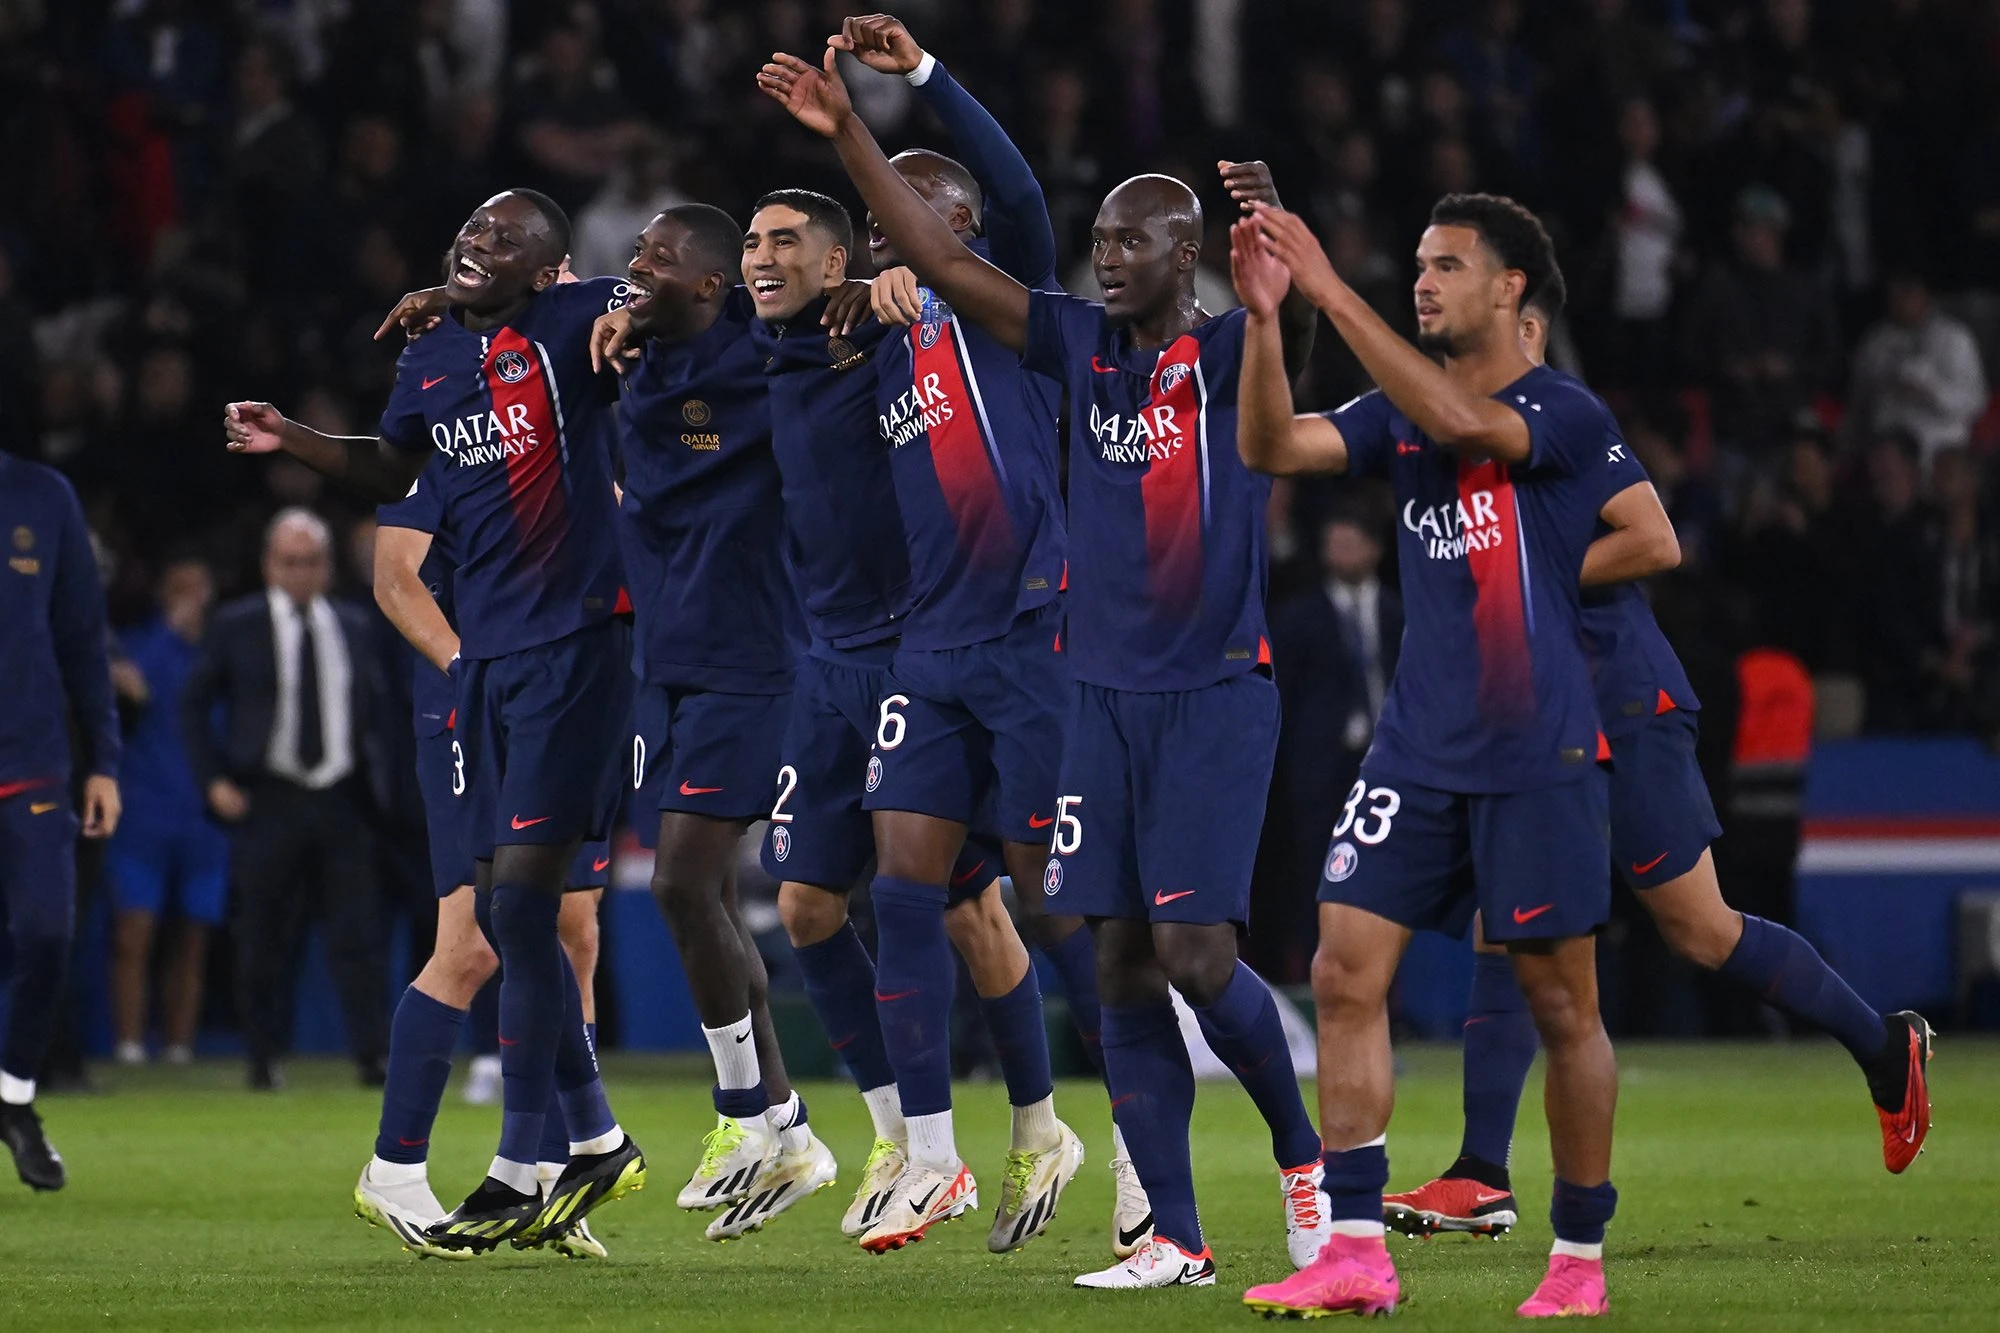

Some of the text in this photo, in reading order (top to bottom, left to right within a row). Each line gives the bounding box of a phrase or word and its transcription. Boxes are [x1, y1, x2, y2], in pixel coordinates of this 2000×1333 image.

[431, 403, 535, 457] QATAR
[459, 432, 539, 468] AIRWAYS
[680, 433, 720, 446] QATAR
[691, 443, 720, 451] AIRWAYS
[891, 401, 953, 449] AIRWAYS
[1089, 403, 1183, 445] QATAR
[872, 694, 910, 750] 6
[452, 740, 466, 795] 3
[771, 765, 798, 823] 2
[1050, 795, 1083, 855] 15
[1333, 779, 1400, 845] 33
